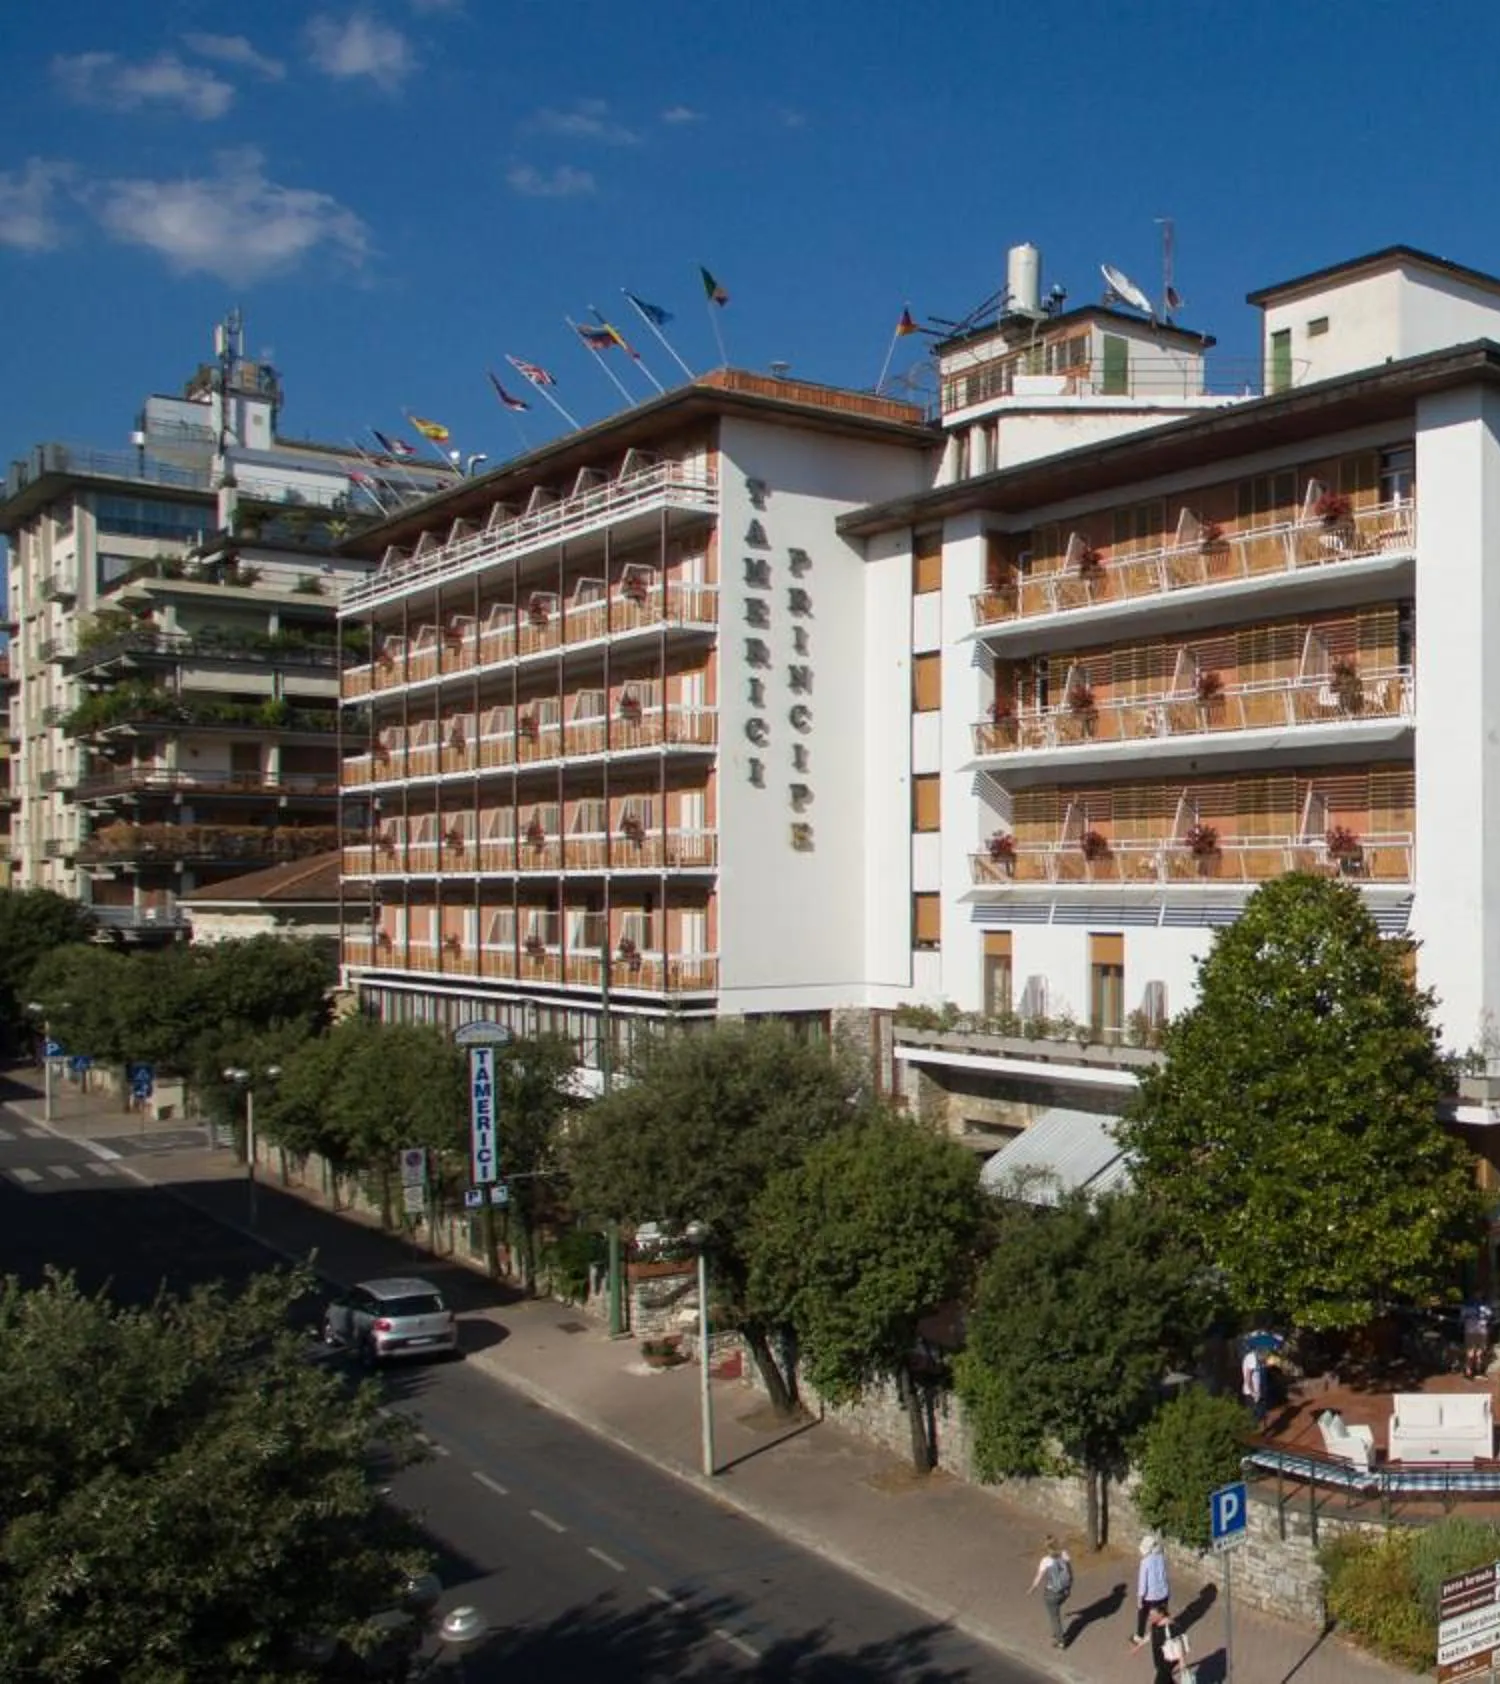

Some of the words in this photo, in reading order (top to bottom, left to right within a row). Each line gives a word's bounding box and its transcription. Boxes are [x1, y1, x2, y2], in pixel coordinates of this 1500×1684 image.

[744, 478, 772, 789] TAMERICI
[787, 547, 814, 852] PRINCIPE
[47, 1042, 60, 1055] P
[475, 1050, 491, 1179] TAMERICI
[1220, 1492, 1239, 1532] P
